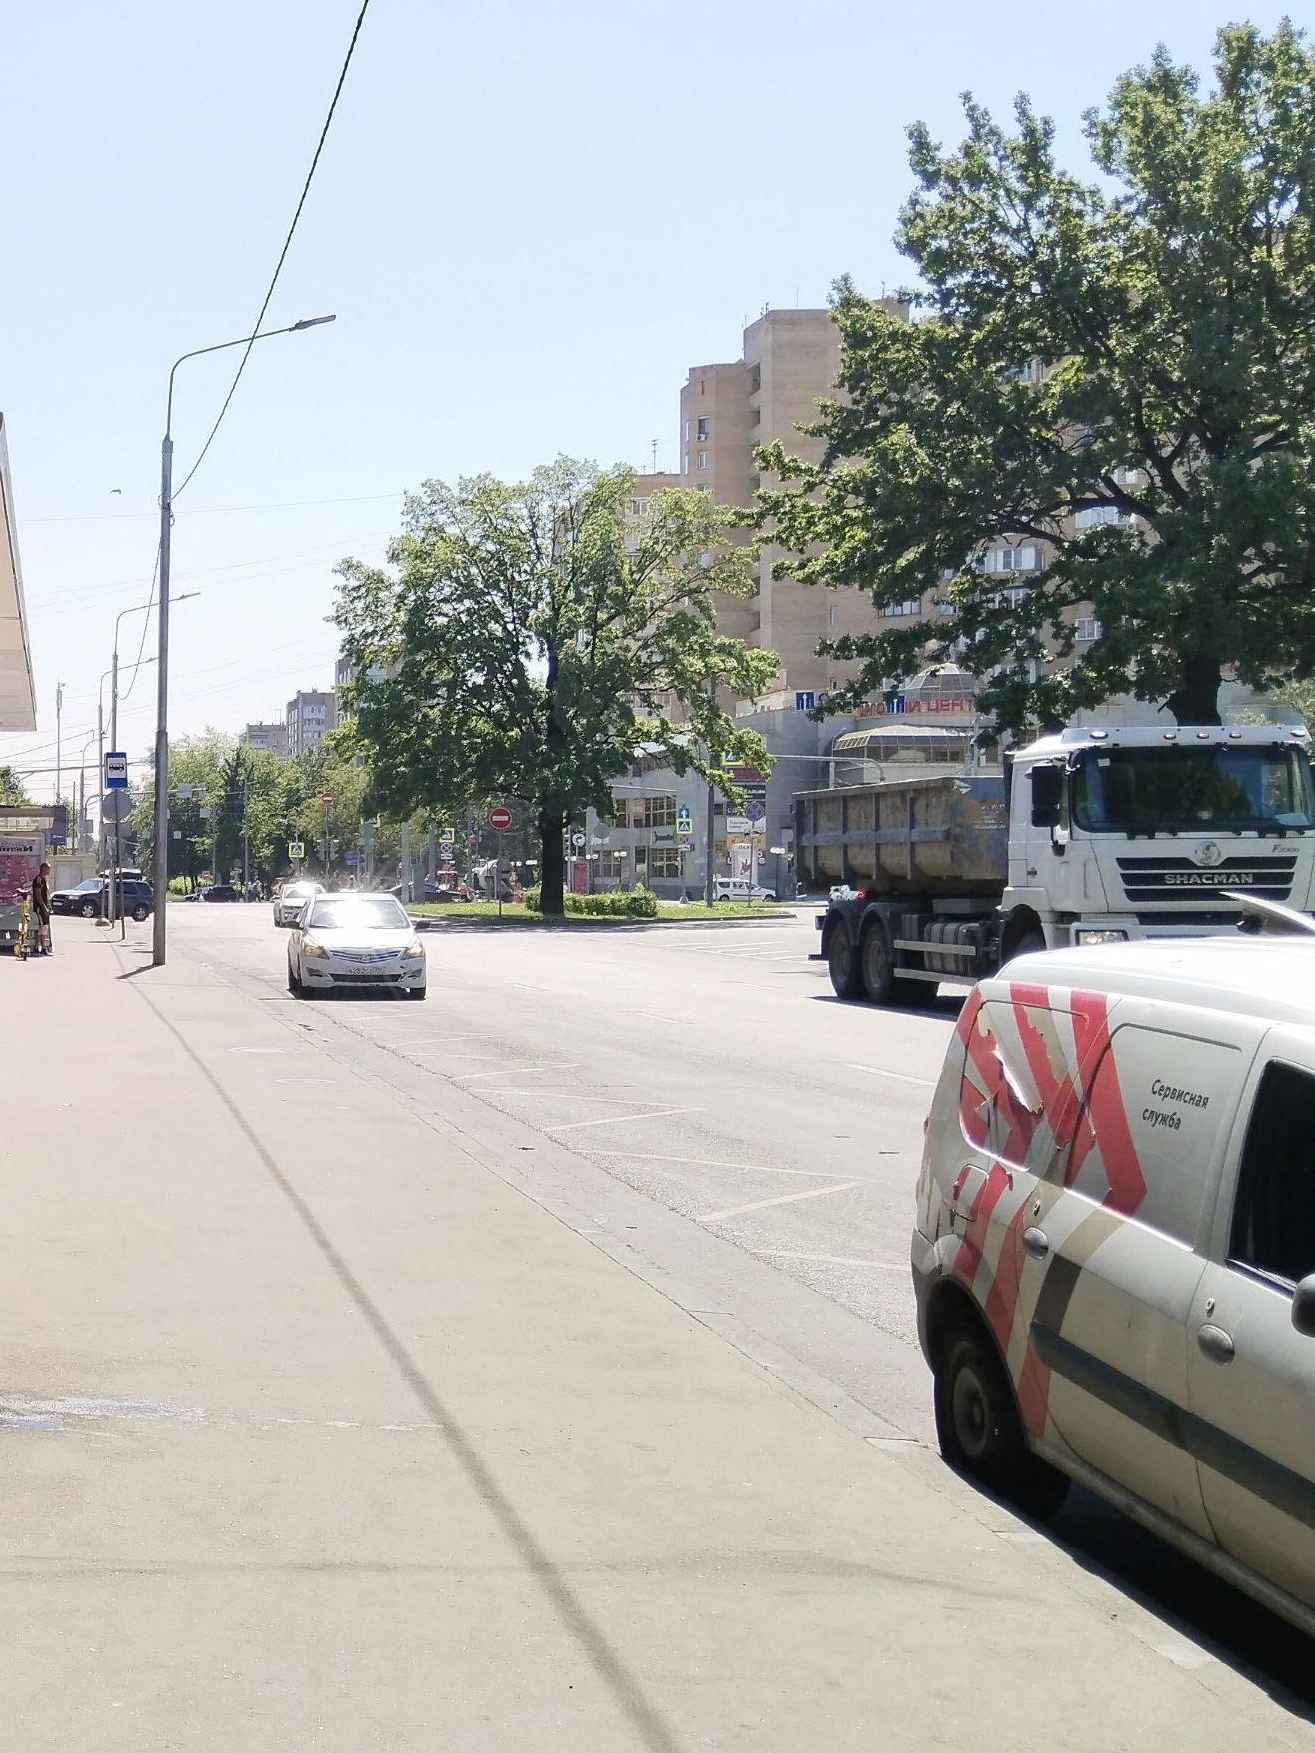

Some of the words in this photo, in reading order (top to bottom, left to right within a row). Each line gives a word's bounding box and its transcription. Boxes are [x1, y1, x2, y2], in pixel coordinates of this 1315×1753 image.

[1163, 873, 1254, 885] SHACMAN
[1151, 1079, 1210, 1109] Сервисная
[1142, 1108, 1182, 1131] служба
